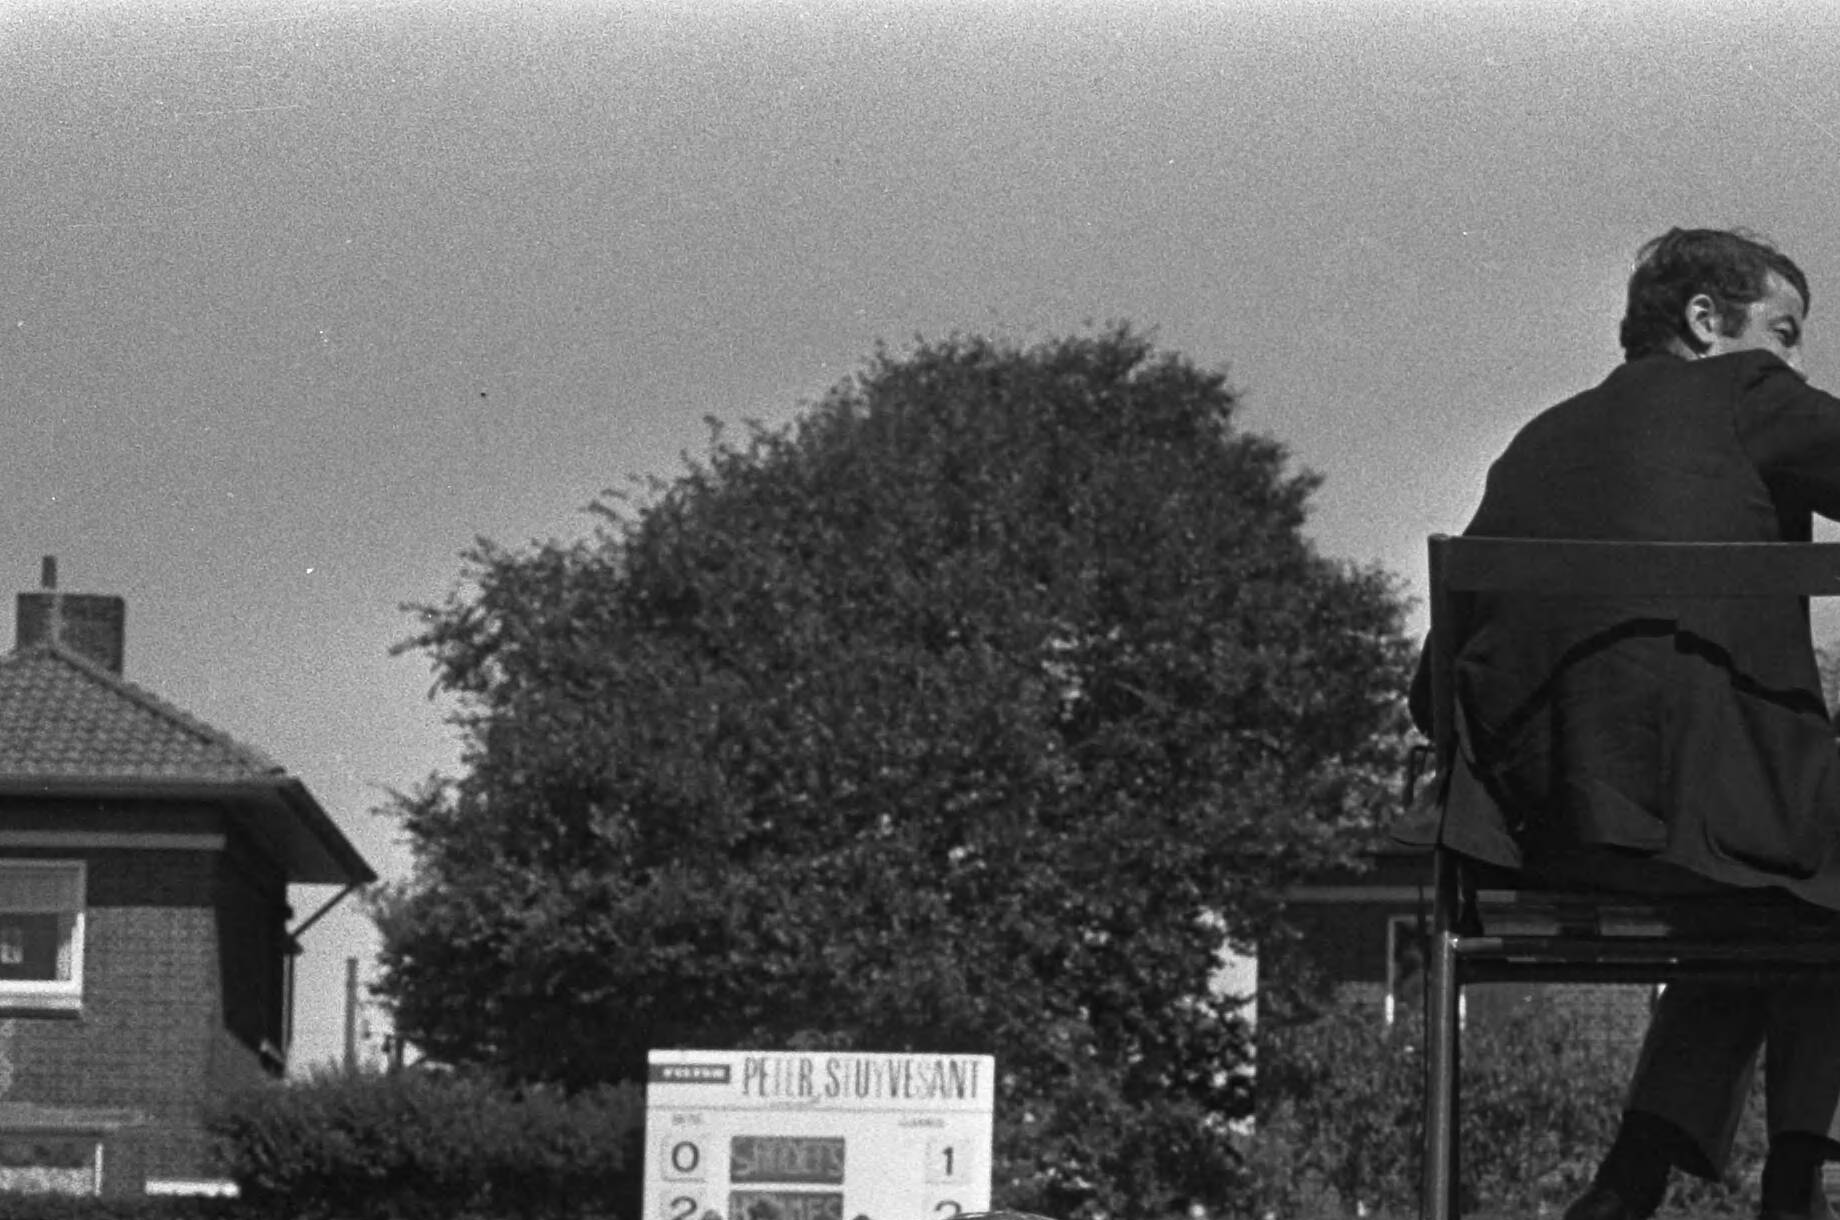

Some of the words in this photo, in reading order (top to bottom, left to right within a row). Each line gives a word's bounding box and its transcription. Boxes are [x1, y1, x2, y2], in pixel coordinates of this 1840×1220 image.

[743, 1056, 813, 1098] PETER
[824, 1057, 980, 1100] STUYVESANT
[671, 1141, 699, 1173] 0
[942, 1146, 955, 1177] 1
